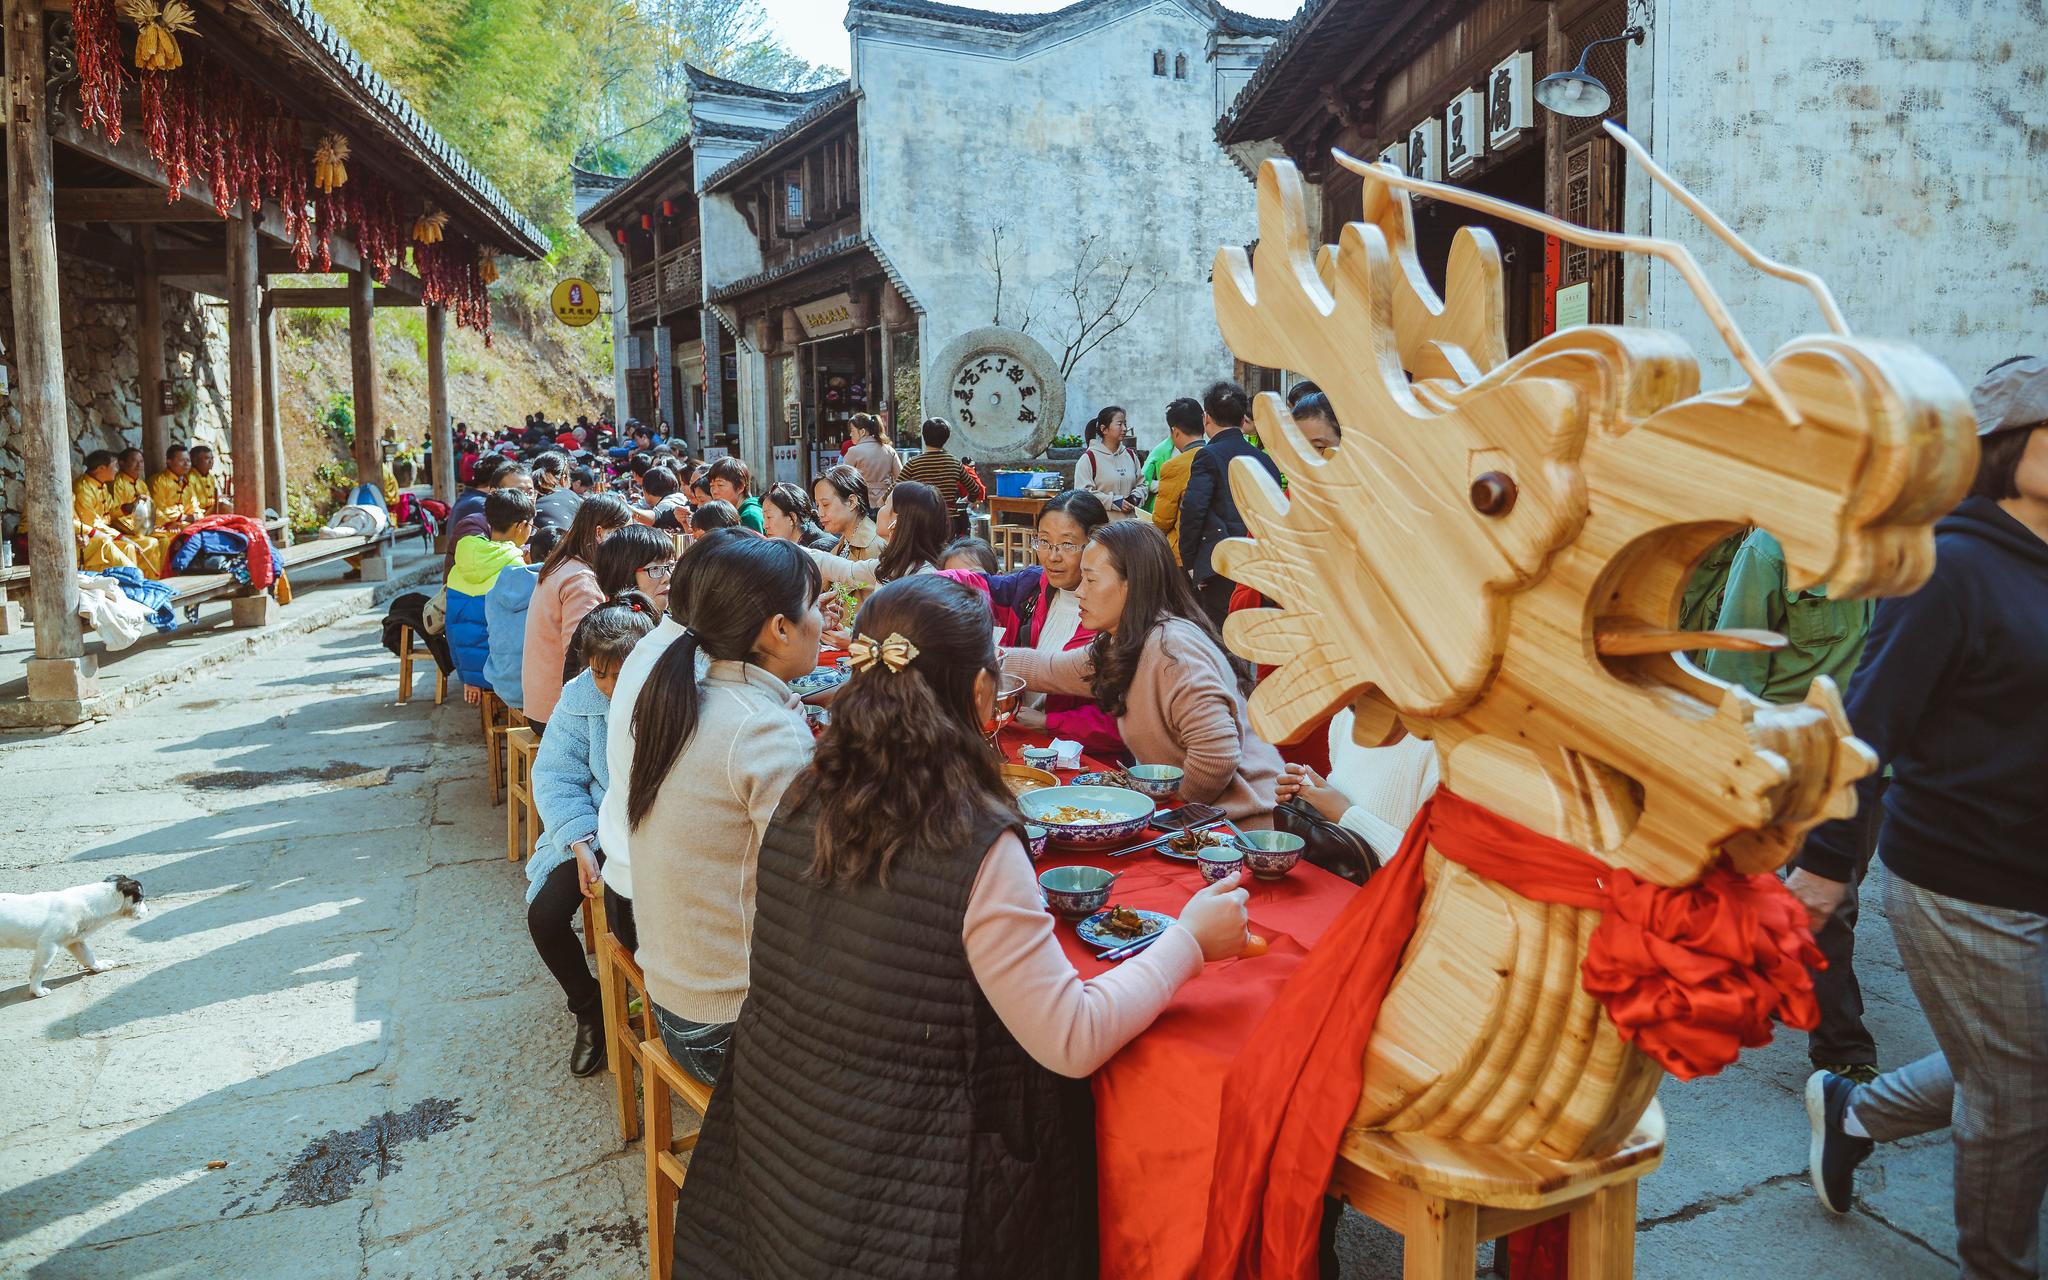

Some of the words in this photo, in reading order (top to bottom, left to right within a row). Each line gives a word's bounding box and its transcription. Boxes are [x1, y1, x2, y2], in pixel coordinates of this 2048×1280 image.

[954, 358, 1037, 427] 心急吃不了热豆腐
